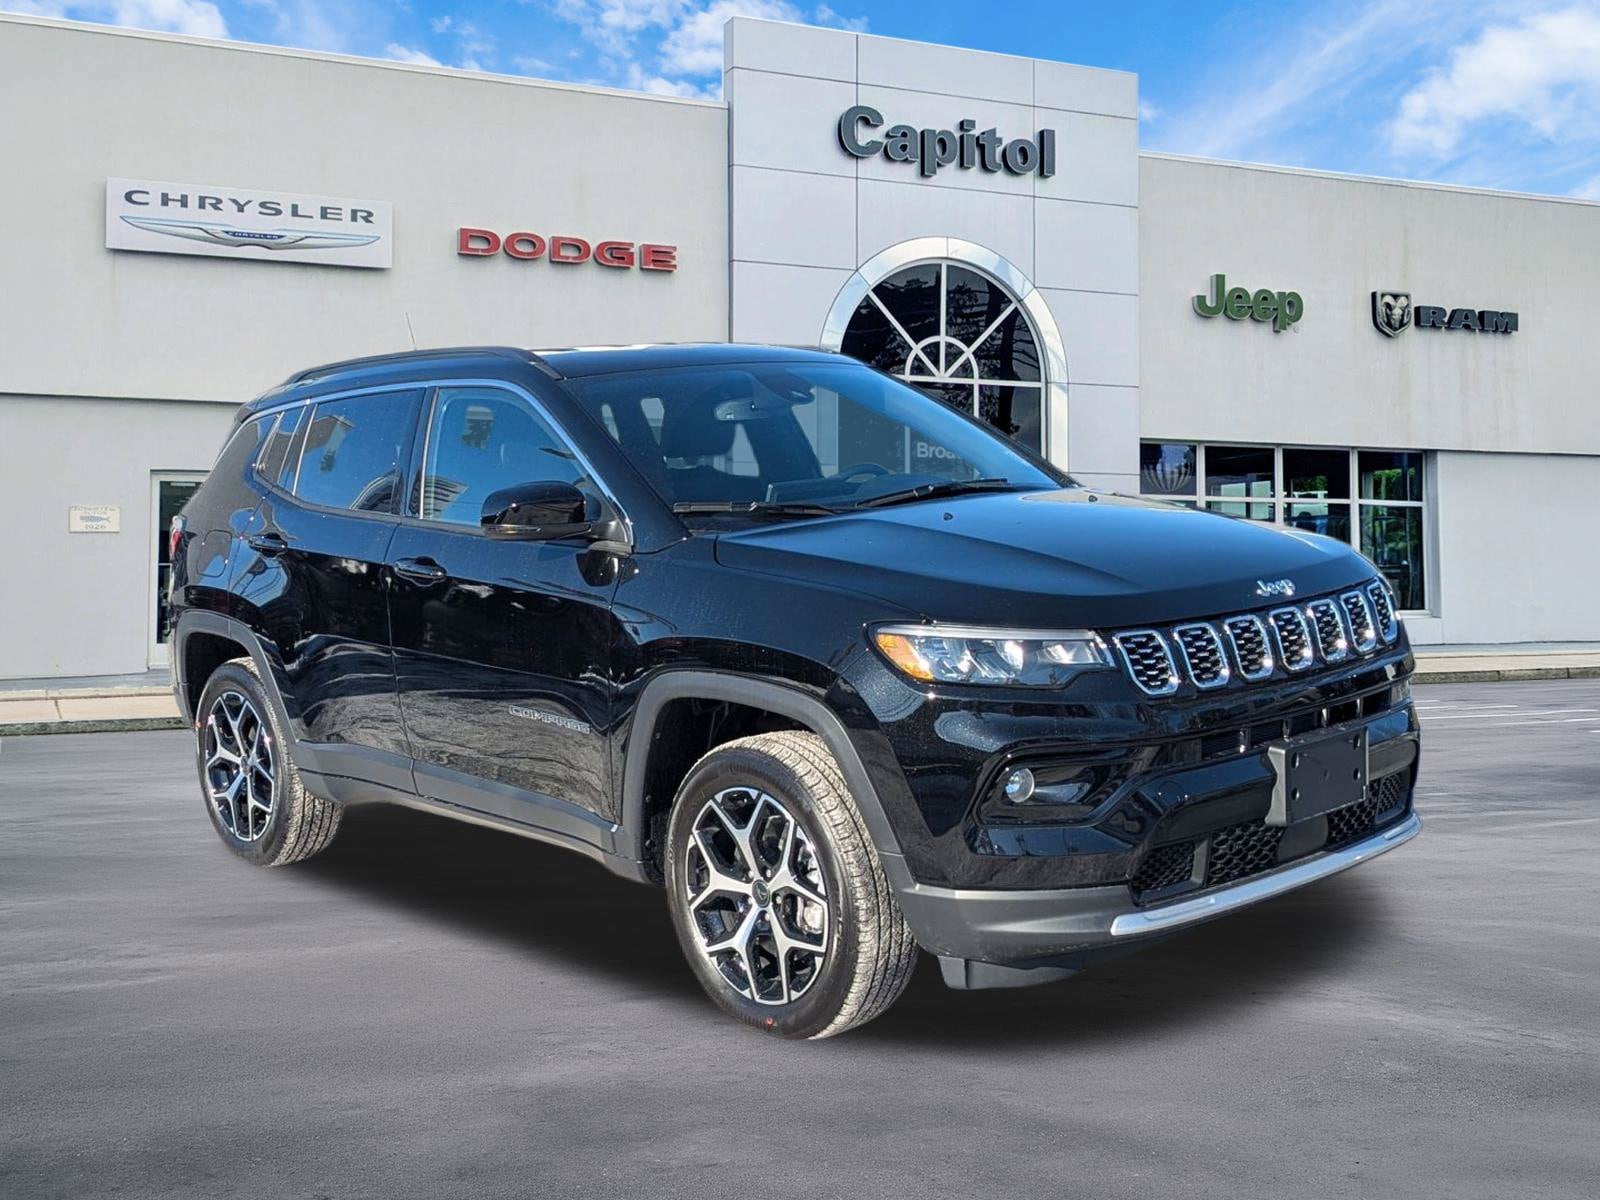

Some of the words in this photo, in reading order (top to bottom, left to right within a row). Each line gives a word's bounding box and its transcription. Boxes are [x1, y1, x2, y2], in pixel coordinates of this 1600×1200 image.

[838, 105, 1056, 178] Capitol
[124, 190, 375, 224] CHRYSLER
[457, 227, 678, 272] DODGE
[1192, 273, 1304, 333] Jeep
[1414, 305, 1520, 334] RAM
[916, 441, 961, 460] Broa
[1256, 579, 1296, 597] Jeep
